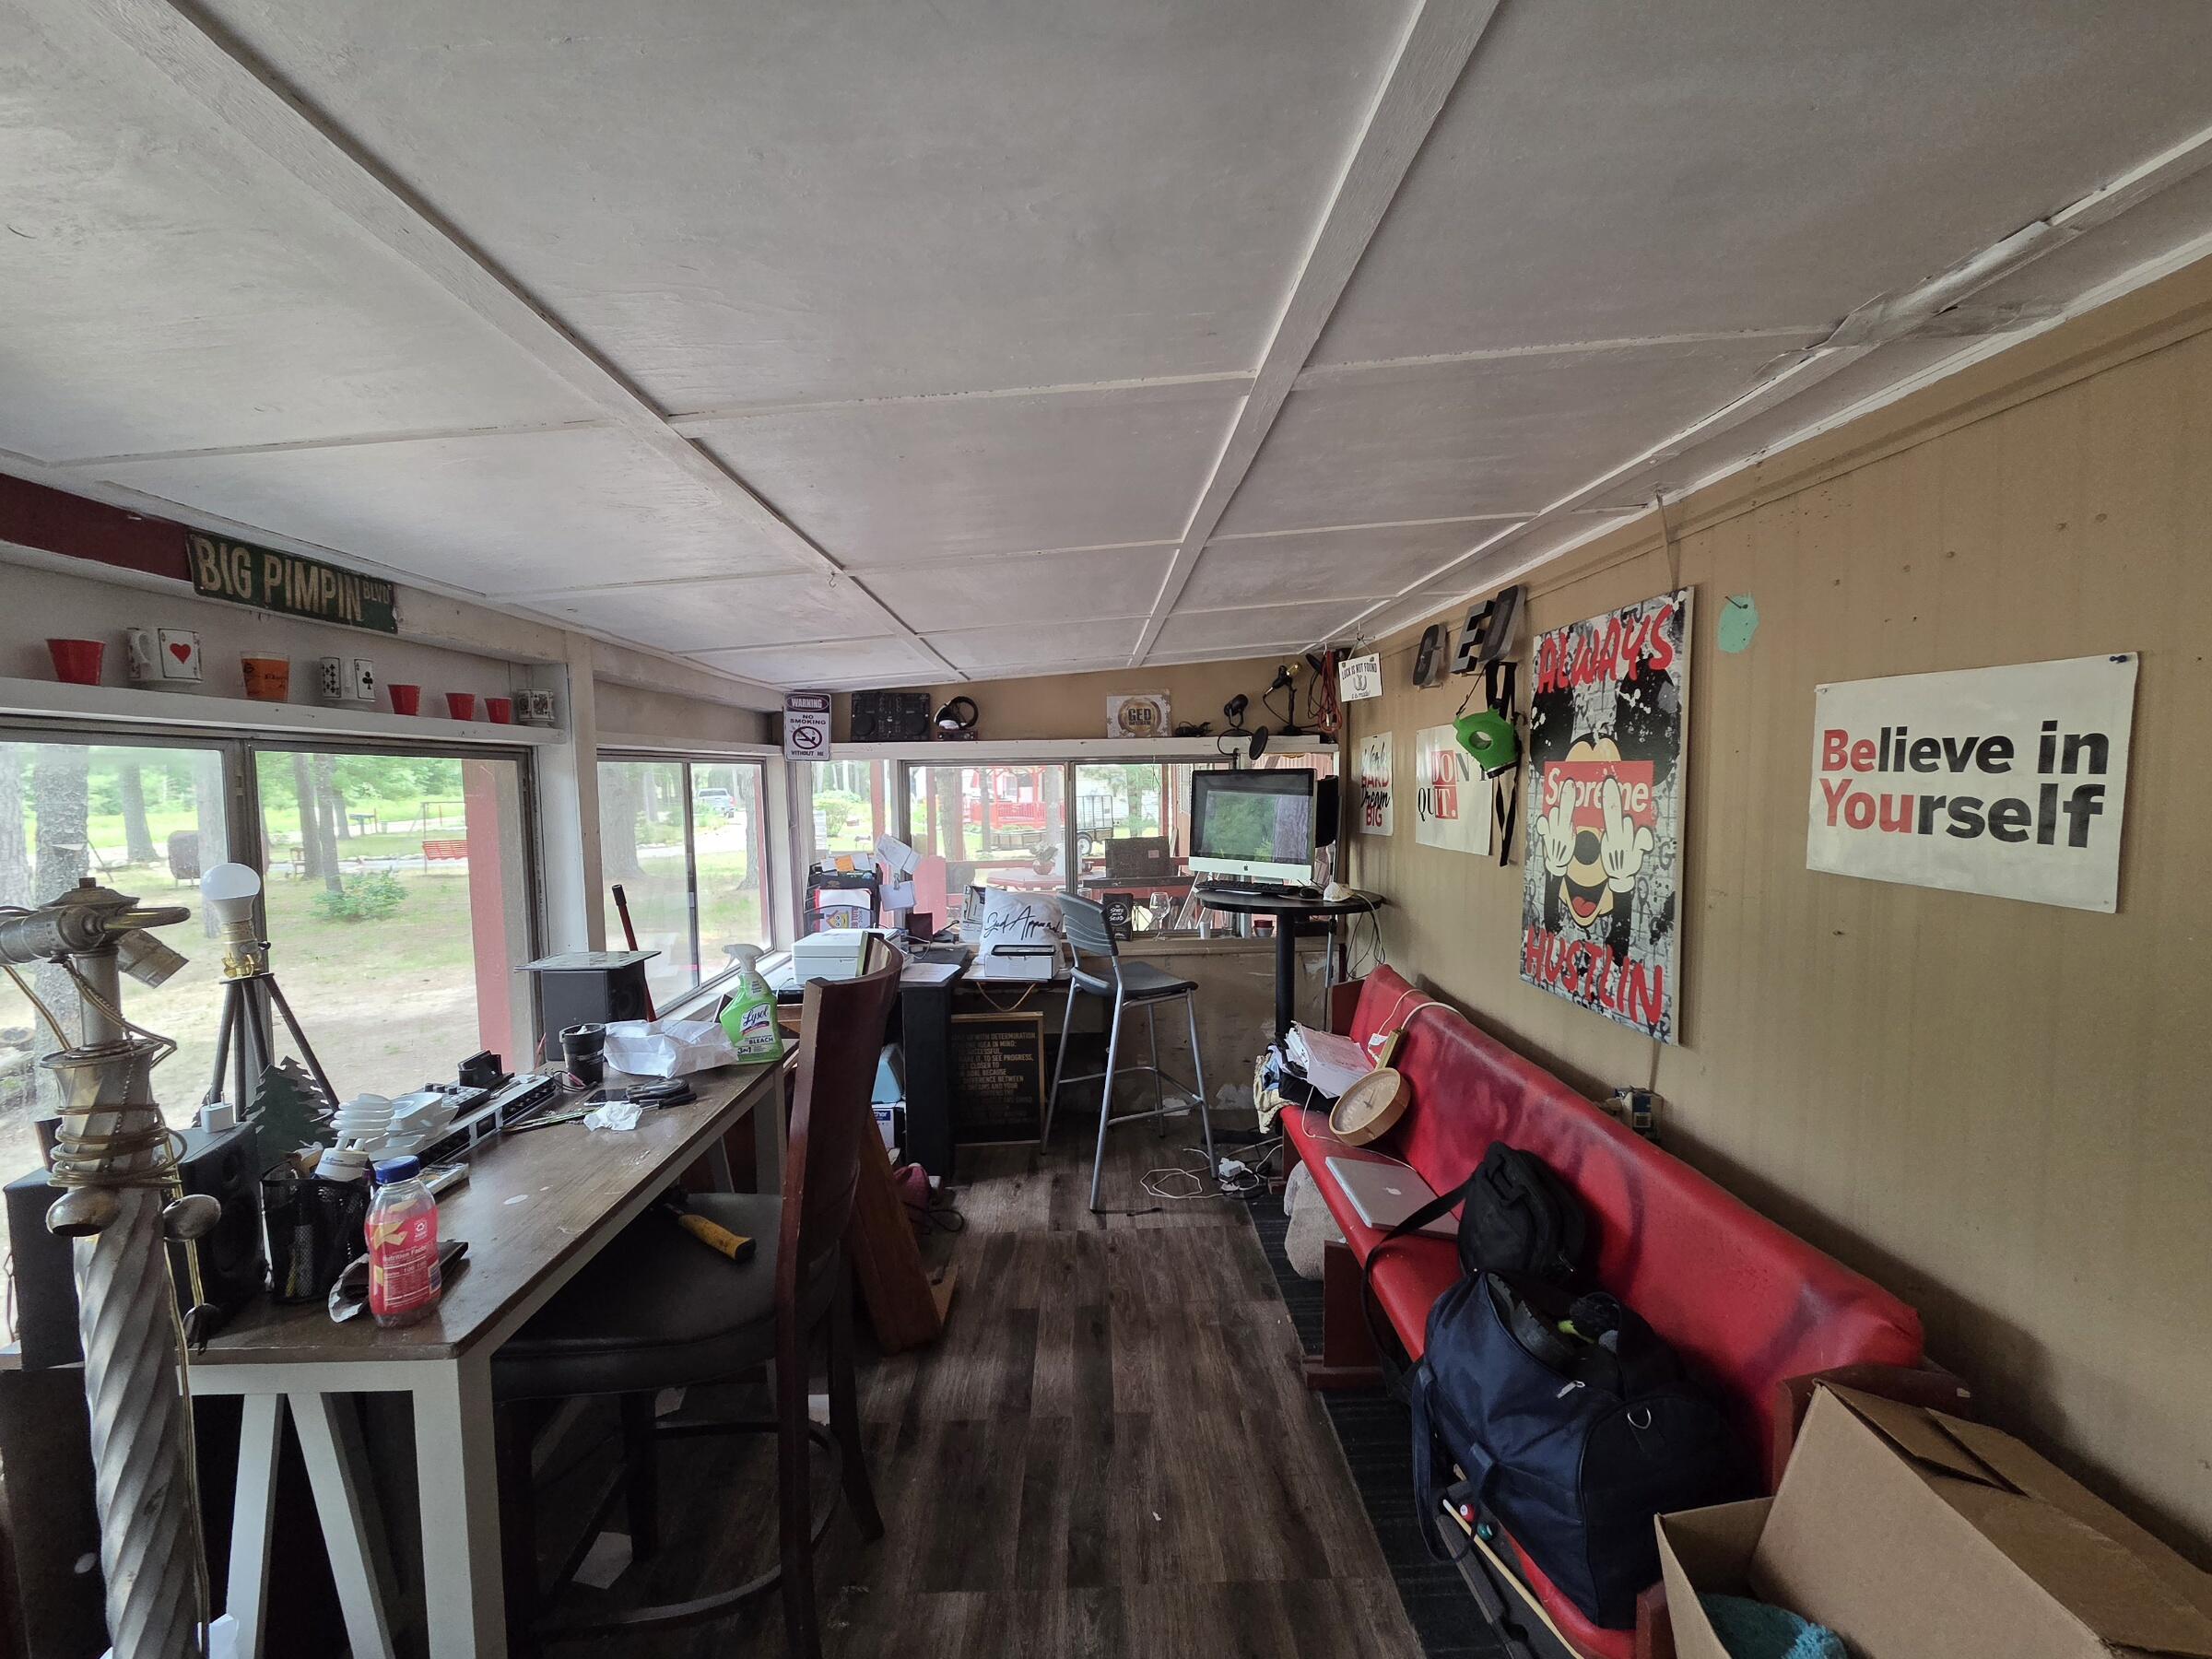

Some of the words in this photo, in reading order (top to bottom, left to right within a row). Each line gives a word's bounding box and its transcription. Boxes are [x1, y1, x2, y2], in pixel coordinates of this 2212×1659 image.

[194, 536, 253, 599] BIG
[264, 554, 364, 622] PIMPIN
[1538, 603, 1675, 694] ALWAYS
[791, 698, 823, 709] WARNING
[1821, 726, 2015, 774] Believe
[2037, 720, 2110, 775] in
[1431, 752, 1488, 782] DON
[1366, 806, 1382, 827] BIG
[1418, 787, 1456, 822] QUIT.
[1818, 777, 2107, 848] Yourself
[1525, 923, 1664, 1025] HUSTLIN
[742, 1005, 770, 1027] Lysol
[749, 1037, 774, 1045] BLEACH
[991, 1032, 1036, 1041] DETERMINATION
